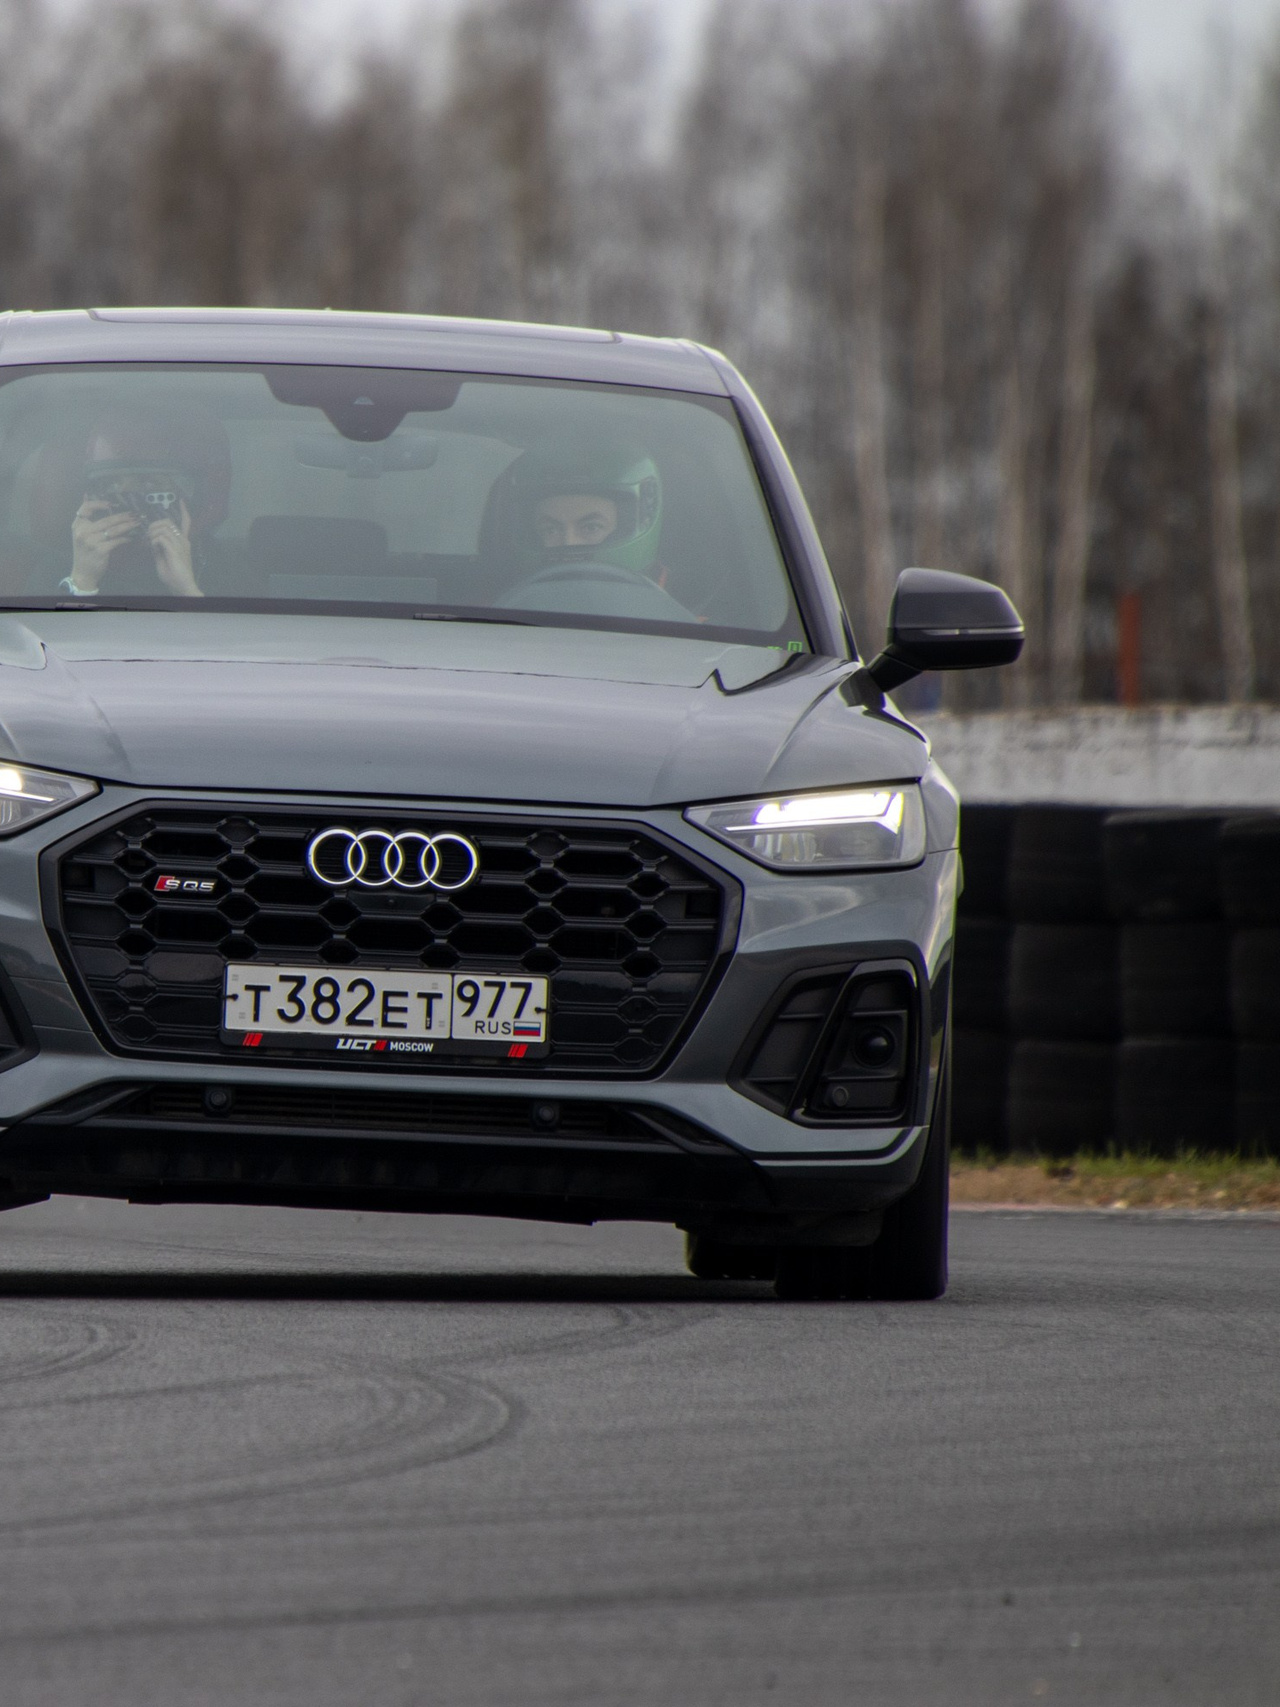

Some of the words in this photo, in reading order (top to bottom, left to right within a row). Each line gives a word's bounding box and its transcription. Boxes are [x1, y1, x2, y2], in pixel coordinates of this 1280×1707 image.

[164, 879, 215, 892] SQ5
[456, 979, 533, 1019] 977
[475, 1020, 512, 1035] RUS
[389, 1041, 434, 1053] MOSCOW
